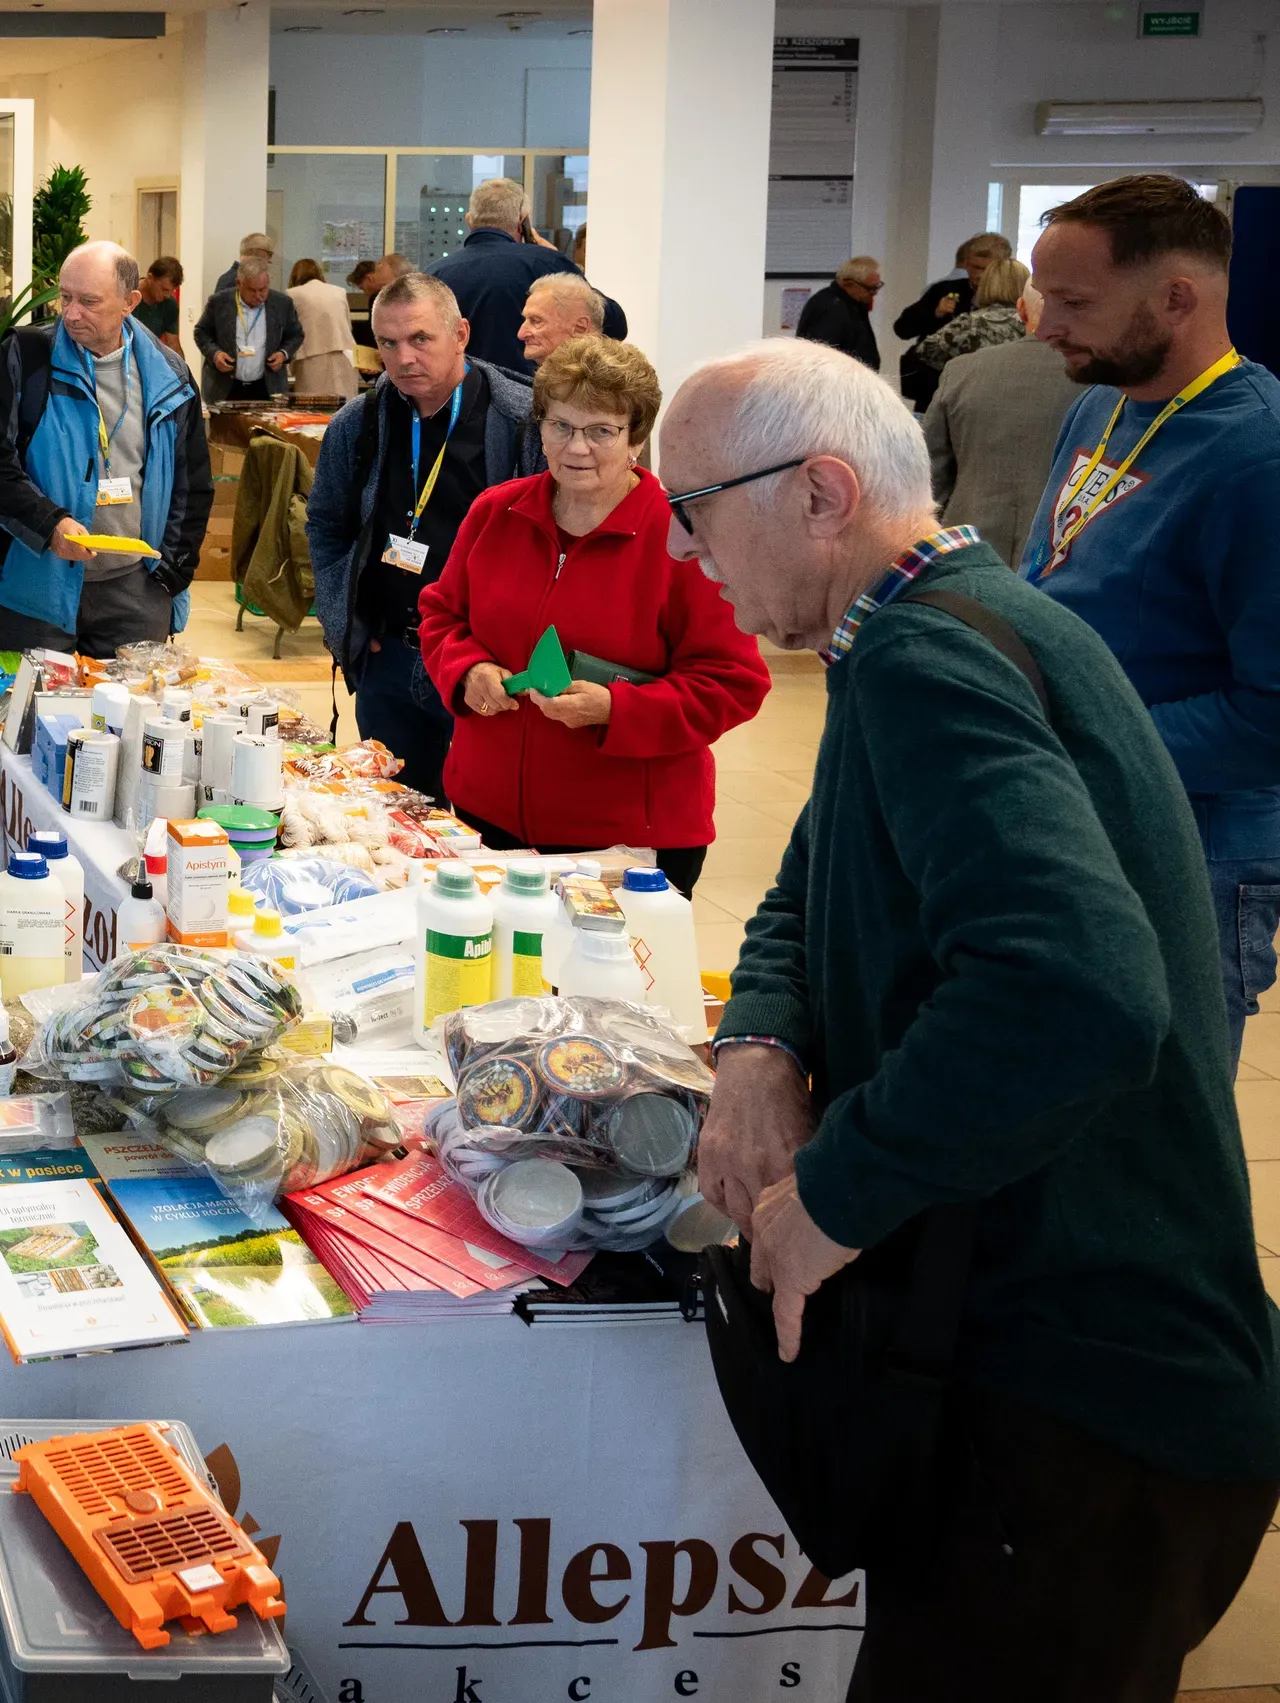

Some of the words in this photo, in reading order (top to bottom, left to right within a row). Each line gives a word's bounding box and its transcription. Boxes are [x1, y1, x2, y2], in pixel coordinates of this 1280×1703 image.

[1067, 464, 1128, 504] GUES
[185, 860, 227, 871] Apistym
[124, 1153, 158, 1162] powrót
[6, 1168, 21, 1178] w
[25, 1164, 84, 1179] pasiece
[380, 1160, 433, 1198] EWIDENCJA
[11, 1203, 56, 1216] optymalny
[153, 1201, 204, 1213] IZOLACJA
[10, 1212, 56, 1224] termicznie
[165, 1210, 200, 1221] CYKLU
